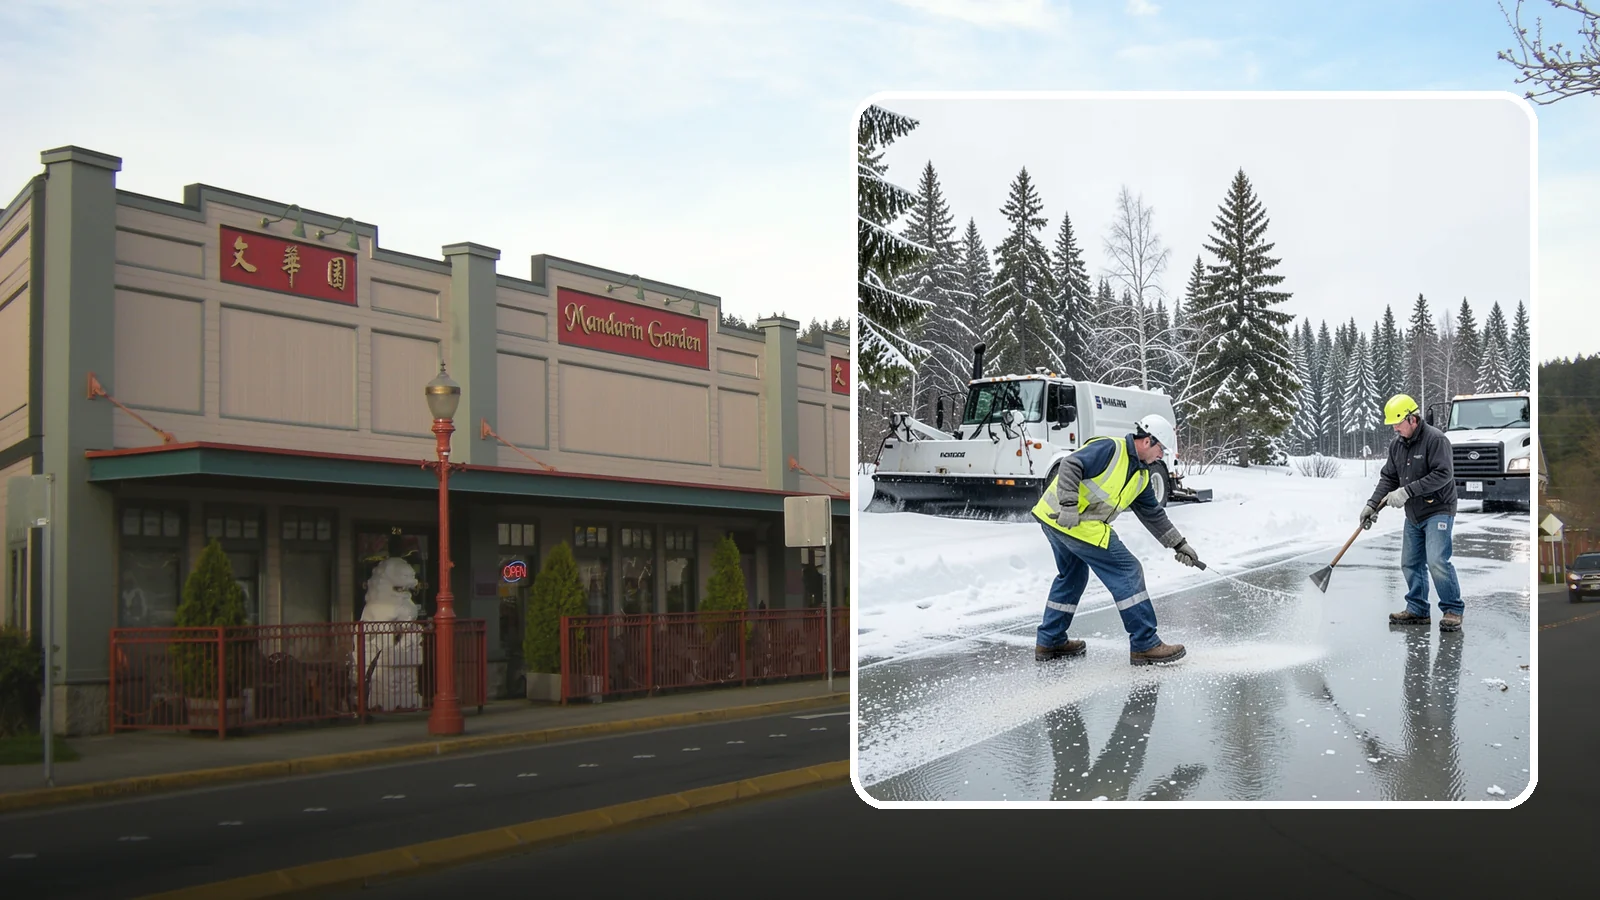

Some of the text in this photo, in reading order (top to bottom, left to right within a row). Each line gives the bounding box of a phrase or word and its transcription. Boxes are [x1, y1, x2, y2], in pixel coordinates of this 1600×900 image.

[230, 235, 346, 291] 文華園
[564, 302, 701, 352] Mandarin Garden
[503, 565, 526, 578] OPEN
